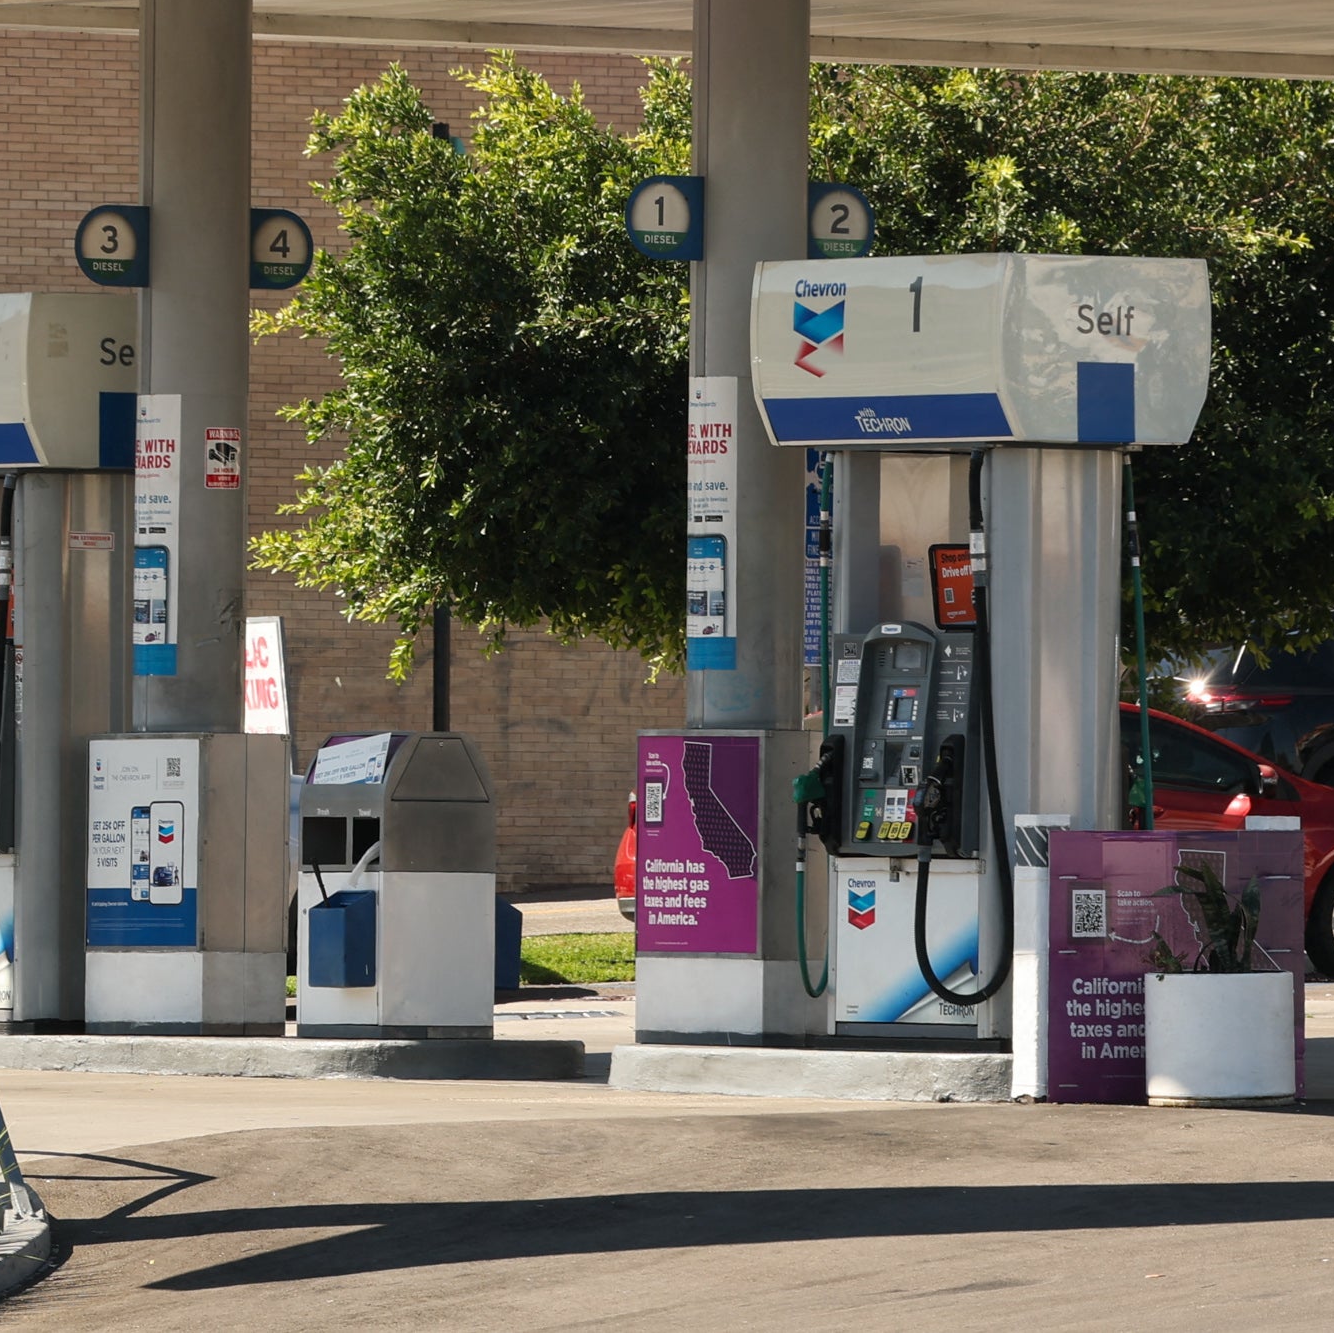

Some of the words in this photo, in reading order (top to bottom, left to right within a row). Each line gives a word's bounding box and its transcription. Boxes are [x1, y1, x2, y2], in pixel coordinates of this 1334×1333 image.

[654, 195, 665, 226] 1
[829, 203, 850, 234] 2
[99, 225, 119, 254] 3
[269, 229, 290, 258] 4
[643, 234, 677, 245] DIESEL
[823, 241, 857, 253] DIESEL
[92, 262, 124, 272] DIESEL
[263, 265, 295, 276] DIESEL
[795, 279, 847, 298] Chevron
[909, 276, 923, 333] 1
[1076, 304, 1135, 337] Self
[99, 337, 135, 367] Se
[858, 407, 876, 419] with
[700, 423, 732, 438] WITH
[854, 416, 912, 435] TECHRON
[144, 439, 175, 453] WITH
[705, 481, 729, 491] save.
[148, 494, 172, 504] save.
[941, 553, 957, 564] Shop
[942, 567, 959, 578] Drive
[960, 565, 969, 576] off
[92, 820, 102, 830] GET
[113, 820, 126, 830] OFF
[92, 833, 101, 843] PER
[102, 833, 126, 843] GALLON
[101, 857, 118, 867] VISITS
[645, 858, 684, 873] California
[686, 858, 705, 873] has
[643, 876, 655, 890] the
[655, 876, 688, 893] highest
[689, 879, 710, 894] gas
[848, 878, 876, 888] Chevron
[1117, 889, 1132, 897] Scan
[644, 894, 664, 908] taxes
[665, 894, 682, 908] and
[683, 894, 707, 908] fees
[1117, 898, 1132, 906] take
[1132, 899, 1155, 907] action.
[648, 911, 656, 925] in
[1066, 999, 1092, 1016] the
[1070, 1021, 1113, 1038] taxes
[1081, 1043, 1095, 1059] in
